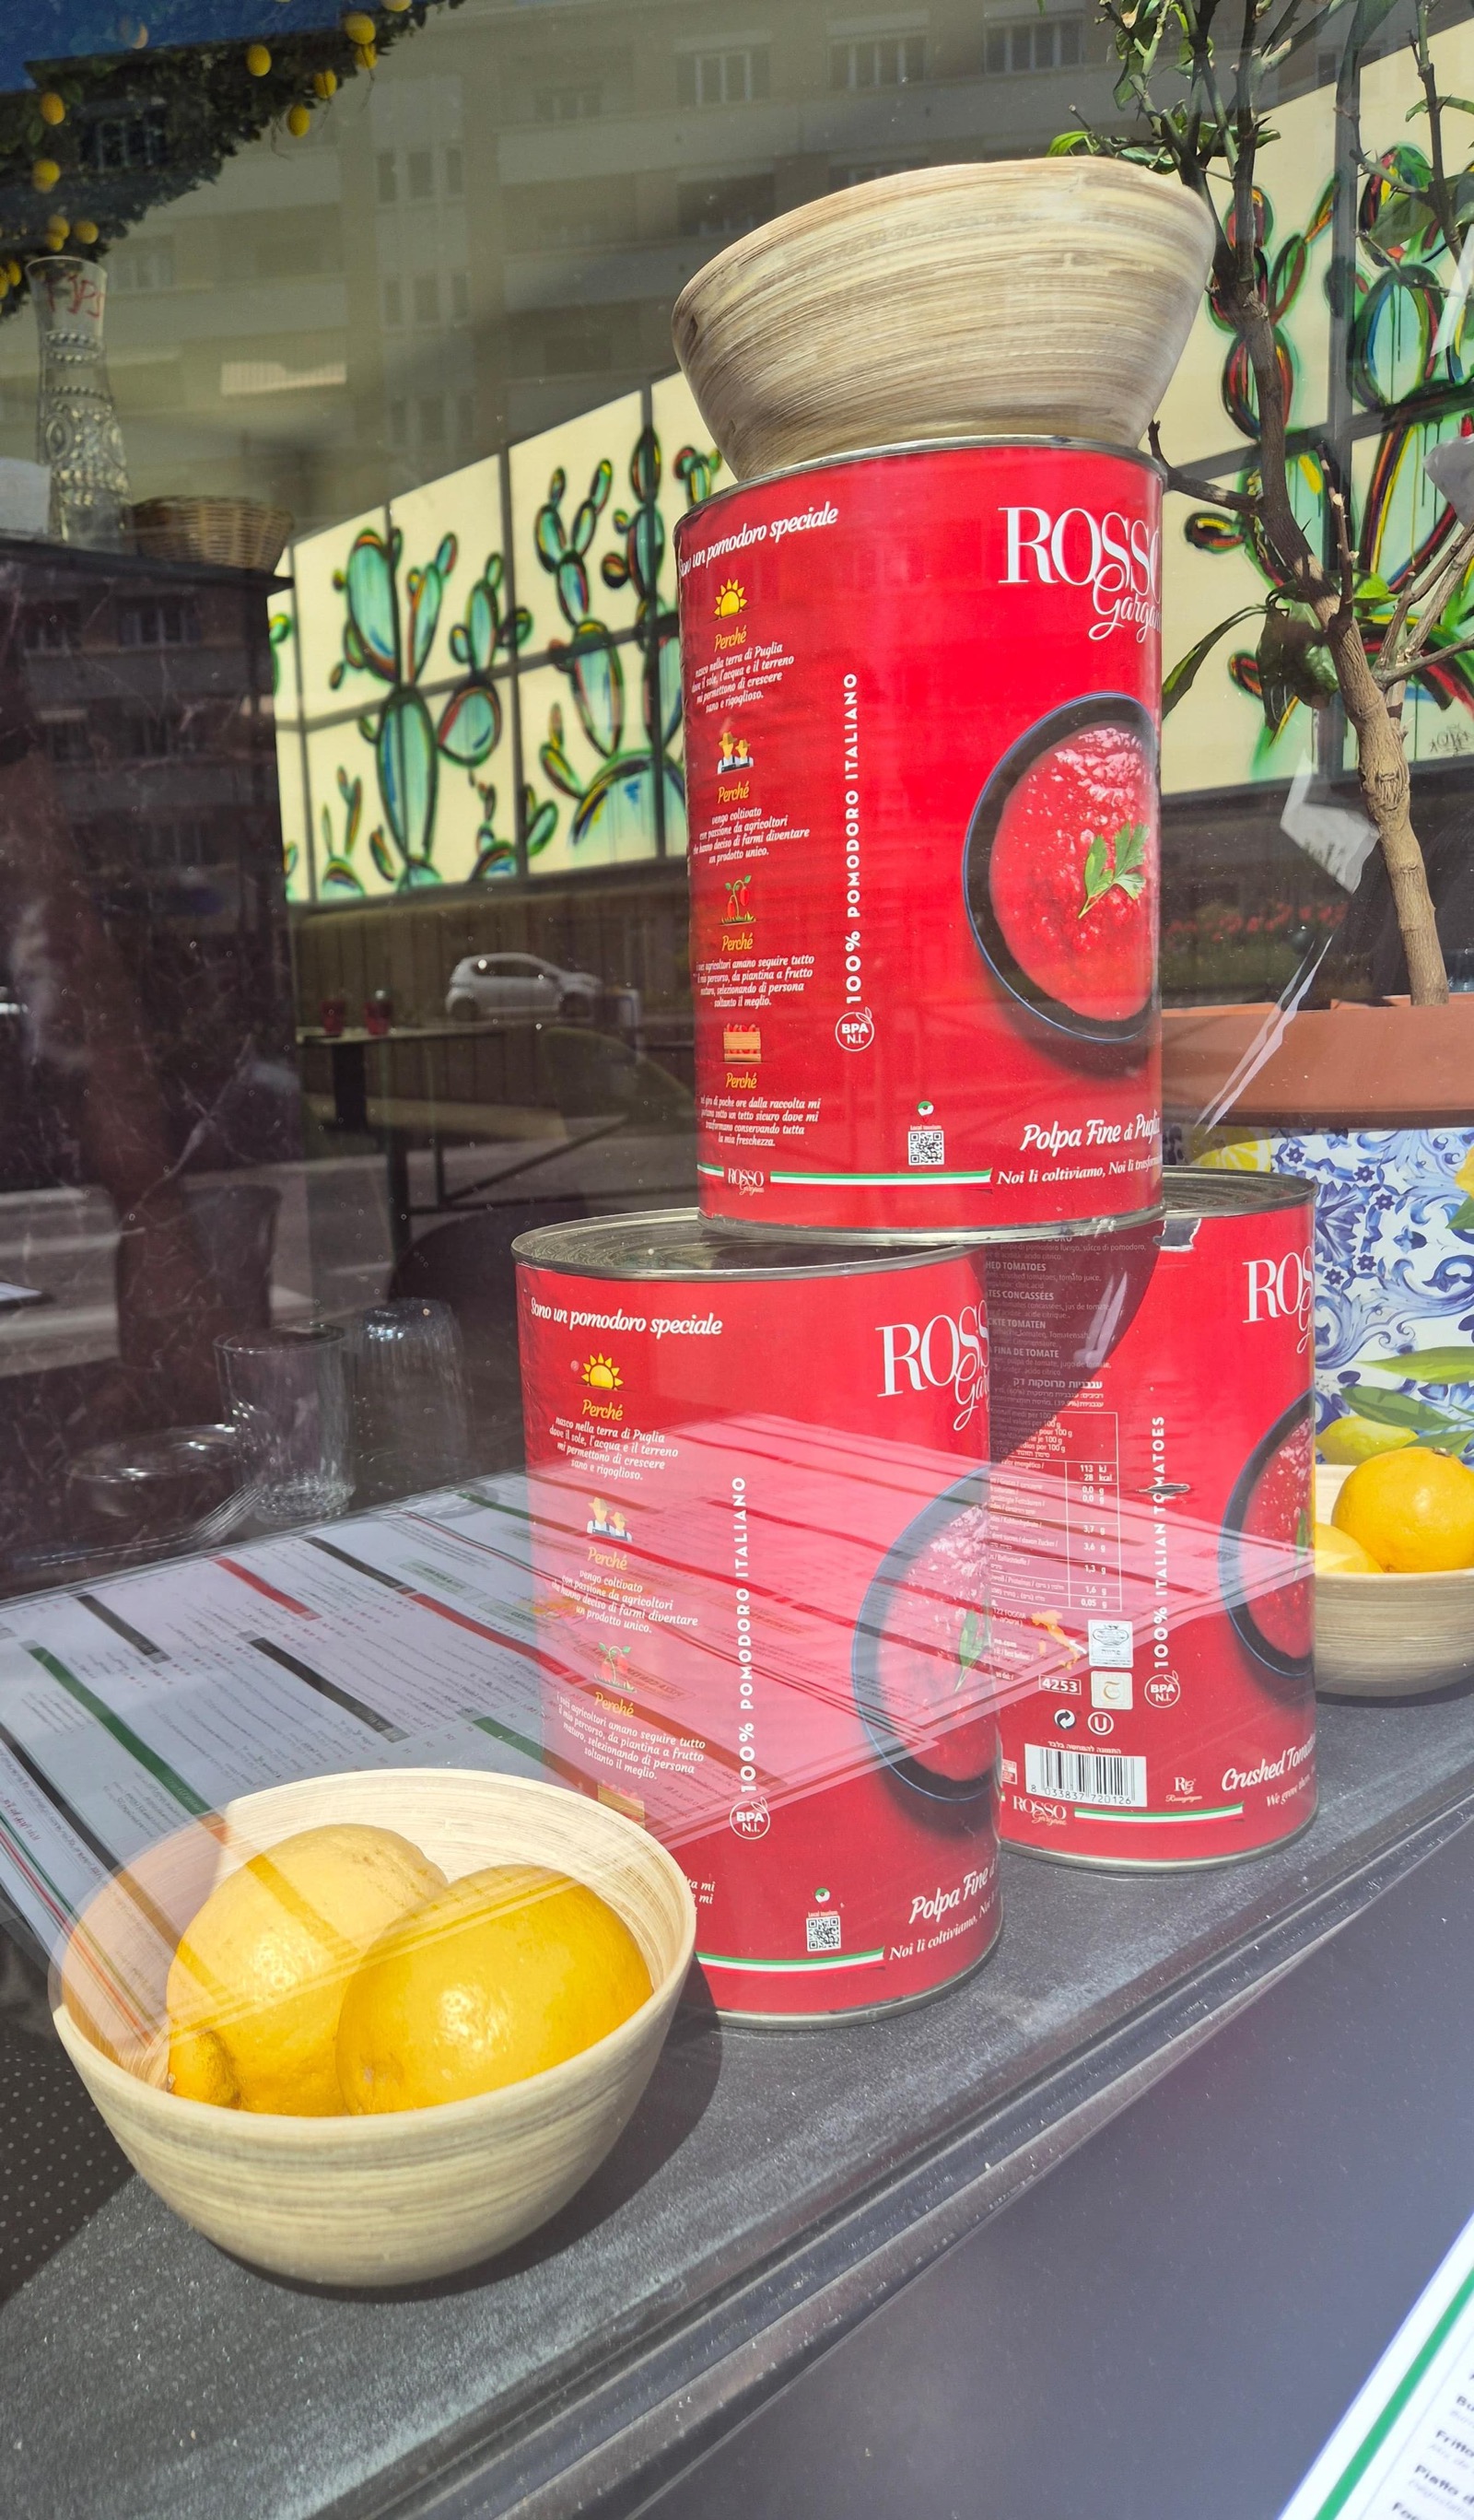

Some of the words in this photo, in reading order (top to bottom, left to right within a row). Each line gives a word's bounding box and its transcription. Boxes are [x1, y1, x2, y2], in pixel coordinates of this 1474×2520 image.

[693, 549, 706, 568] un
[707, 523, 766, 568] pomodoro
[769, 501, 838, 543] speciale
[715, 625, 746, 652] Perché
[726, 654, 743, 666] terra
[744, 648, 752, 660] di
[755, 641, 783, 659] Puglia
[753, 660, 759, 672] il
[762, 656, 794, 672] terreno
[738, 677, 744, 689] di
[747, 673, 782, 687] crescere
[726, 691, 764, 709] rigoglioso.
[844, 673, 859, 779] ITALIANO
[718, 781, 749, 803] Perché
[712, 815, 728, 827] vengo
[730, 807, 762, 821] coltivato
[733, 822, 743, 834] da
[744, 815, 788, 834] agricoltori
[733, 835, 740, 846] di
[743, 832, 764, 848] farmi
[766, 828, 810, 842] diventare
[745, 846, 769, 858] unico.
[846, 791, 860, 918] POMODORO
[722, 932, 753, 951] Perché
[732, 959, 755, 969] amano
[758, 955, 788, 969] seguire
[791, 955, 814, 965] tutto
[845, 930, 861, 1003] 100%
[731, 970, 740, 981] da
[742, 970, 774, 984] piantina
[785, 967, 813, 980] frutto
[758, 981, 766, 993] di
[768, 982, 804, 995] persona
[744, 995, 771, 1009] meglio.
[841, 1024, 869, 1035] BPA
[726, 1072, 757, 1088] Perché
[749, 1097, 766, 1108] dalla
[770, 1097, 805, 1109] raccolta
[808, 1098, 821, 1109] mi
[738, 1111, 754, 1120] tetto
[755, 1111, 779, 1121] sicuro
[782, 1110, 802, 1121] dove
[806, 1111, 819, 1122] mi
[734, 1122, 779, 1134] conservando
[782, 1125, 804, 1135] tutta
[1020, 1121, 1082, 1157] Polpa
[1086, 1119, 1121, 1145] Fine
[1124, 1123, 1133, 1141] di
[736, 1135, 776, 1146] freschezza.
[728, 1168, 764, 1187] ROSSO
[996, 1169, 1024, 1185] Noi
[1029, 1169, 1038, 1183] li
[1041, 1166, 1106, 1182] coltiviamo,
[1108, 1161, 1126, 1176] Noi
[1002, 1261, 1047, 1272] TOMATOES
[532, 1297, 551, 1319] Sono
[554, 1308, 567, 1324] un
[570, 1309, 646, 1330] pomodoro
[650, 1313, 722, 1340] speciale
[1008, 1319, 1046, 1330] TOMATEN
[1025, 1348, 1059, 1358] TOMATE
[582, 1399, 623, 1421] Perché
[550, 1424, 564, 1436] dove
[571, 1433, 587, 1447] sole,
[590, 1436, 620, 1452] l'acqua
[631, 1442, 638, 1454] il
[641, 1445, 678, 1458] terreno
[556, 1416, 573, 1429] nasco
[575, 1421, 594, 1434] nella
[597, 1426, 618, 1437] terra
[621, 1427, 630, 1439] di
[633, 1429, 665, 1445] Puglia
[557, 1441, 566, 1451] mi
[567, 1445, 610, 1462] permettono
[613, 1454, 621, 1465] di
[625, 1458, 665, 1470] crescere
[1152, 1416, 1165, 1514] TOMATOES
[571, 1459, 588, 1471] sano
[597, 1464, 643, 1480] rigoglioso.
[731, 1477, 748, 1577] ITALIANO
[588, 1547, 627, 1570] Perché
[1154, 1523, 1167, 1596] ITALIAN
[579, 1570, 602, 1584] vengo
[604, 1576, 643, 1593] coltivato
[575, 1580, 606, 1598] passione
[609, 1589, 619, 1601] da
[623, 1595, 673, 1611] agricoltori
[582, 1595, 606, 1610] deciso
[608, 1601, 617, 1612] di
[619, 1604, 646, 1619] farmi
[649, 1612, 698, 1626] diventare
[587, 1610, 621, 1627] prodotto
[624, 1621, 652, 1633] unico.
[736, 1588, 754, 1709] POMODORO
[1154, 1606, 1168, 1668] 100%
[1042, 1678, 1078, 1692] 4253
[1151, 1685, 1176, 1694] BPA
[594, 1692, 634, 1718] Perché
[571, 1704, 606, 1727] agricoltori
[608, 1721, 638, 1737] amano
[640, 1728, 676, 1745] seguire
[679, 1737, 706, 1750] tutto
[564, 1721, 586, 1743] maturo,
[588, 1736, 638, 1763] selezionando
[642, 1754, 651, 1765] di
[654, 1759, 695, 1774] persona
[574, 1717, 605, 1741] percorso,
[608, 1733, 618, 1744] da
[621, 1737, 660, 1755] piantina
[672, 1747, 704, 1763] frutto
[584, 1746, 614, 1767] soltanto
[625, 1764, 657, 1780] meglio.
[739, 1722, 756, 1792] 100%
[1222, 1750, 1286, 1791] Crushed
[1045, 1787, 1084, 1800] 033837
[1092, 1794, 1131, 1804] 720126
[736, 1812, 765, 1823] BPA
[1012, 1796, 1067, 1820] ROSSO
[701, 1881, 716, 1893] mi
[908, 1887, 960, 1924] Polpa
[963, 1868, 988, 1901] Fine
[699, 1893, 714, 1905] mi
[889, 1942, 913, 1961] Noi
[917, 1939, 926, 1952] li
[928, 1915, 977, 1948] coltiviamo,
